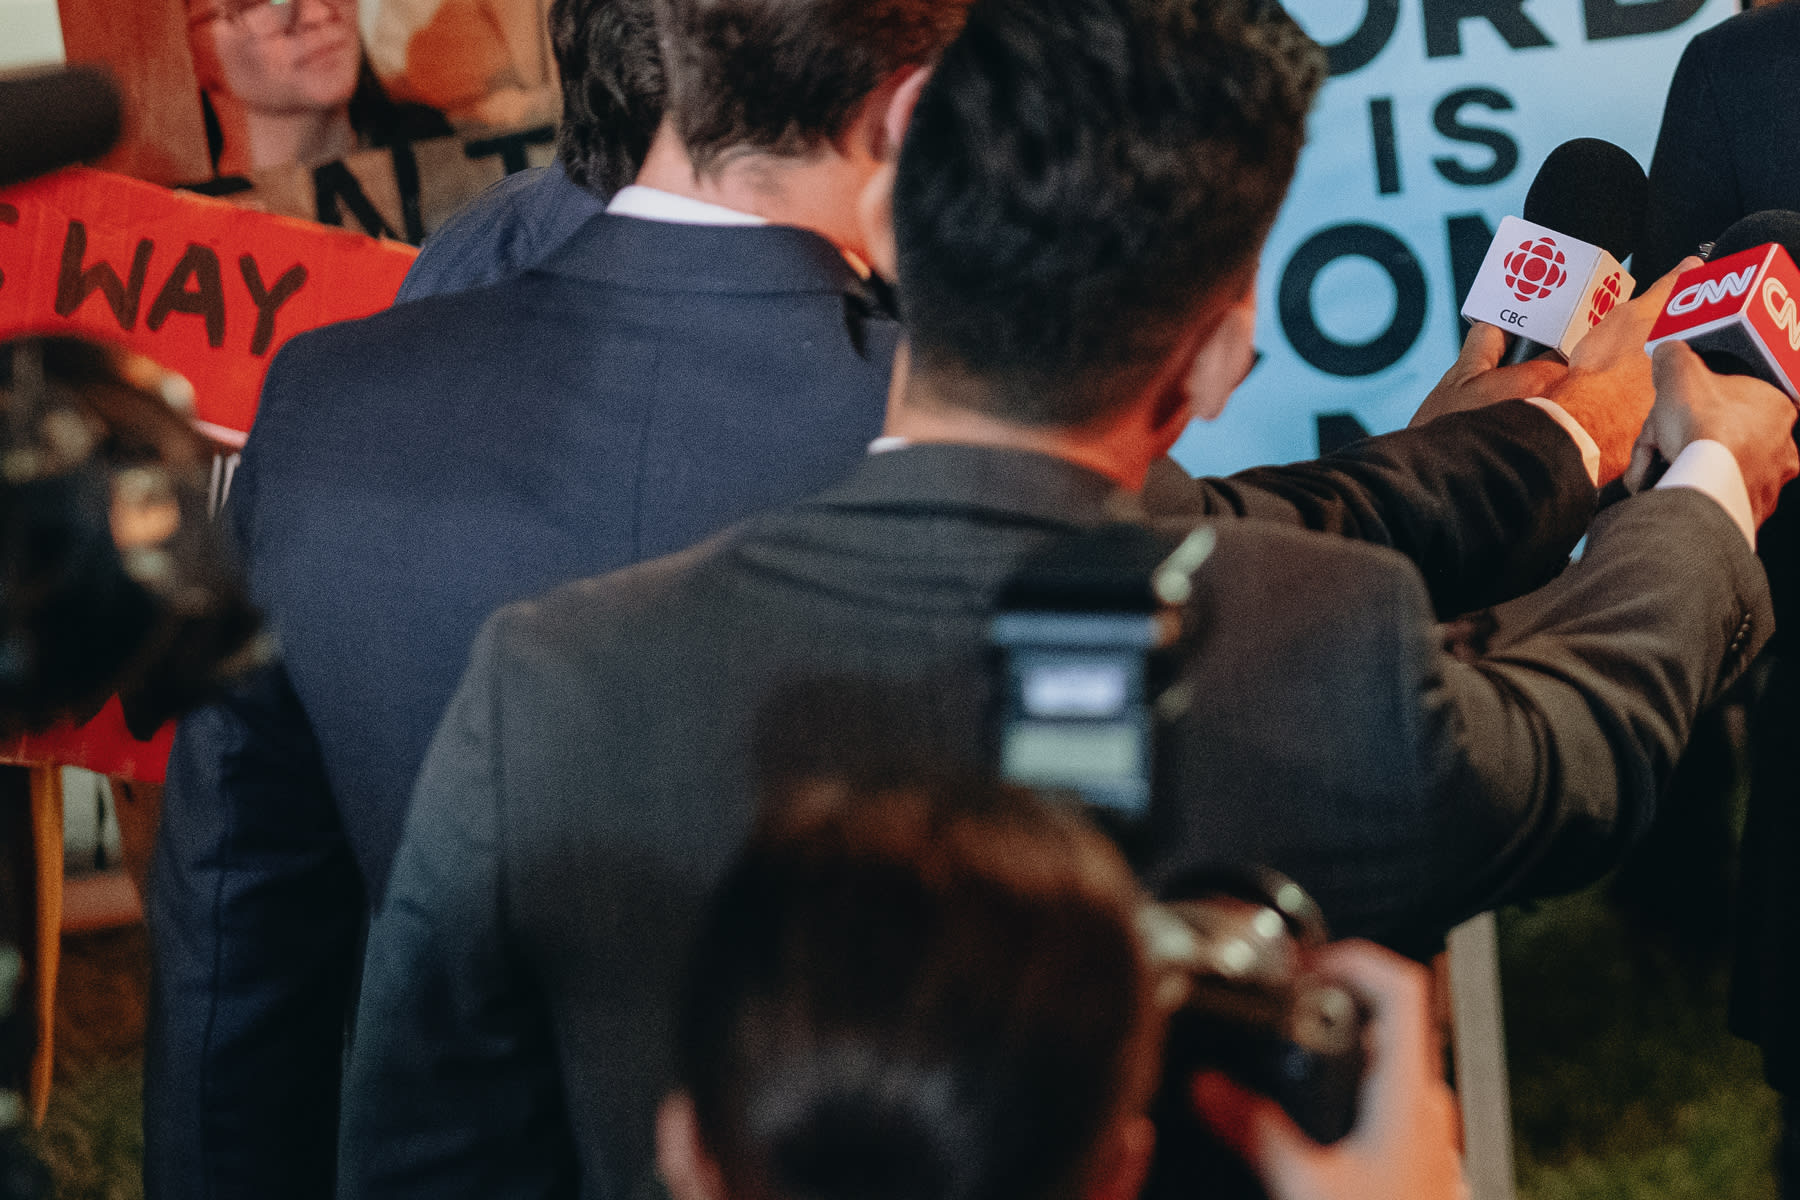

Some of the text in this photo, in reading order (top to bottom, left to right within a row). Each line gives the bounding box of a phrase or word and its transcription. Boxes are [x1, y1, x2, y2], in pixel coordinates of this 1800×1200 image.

[1368, 86, 1519, 195] IS
[55, 220, 308, 357] WAY
[1500, 309, 1529, 328] CBC
[1666, 264, 1758, 316] CNN
